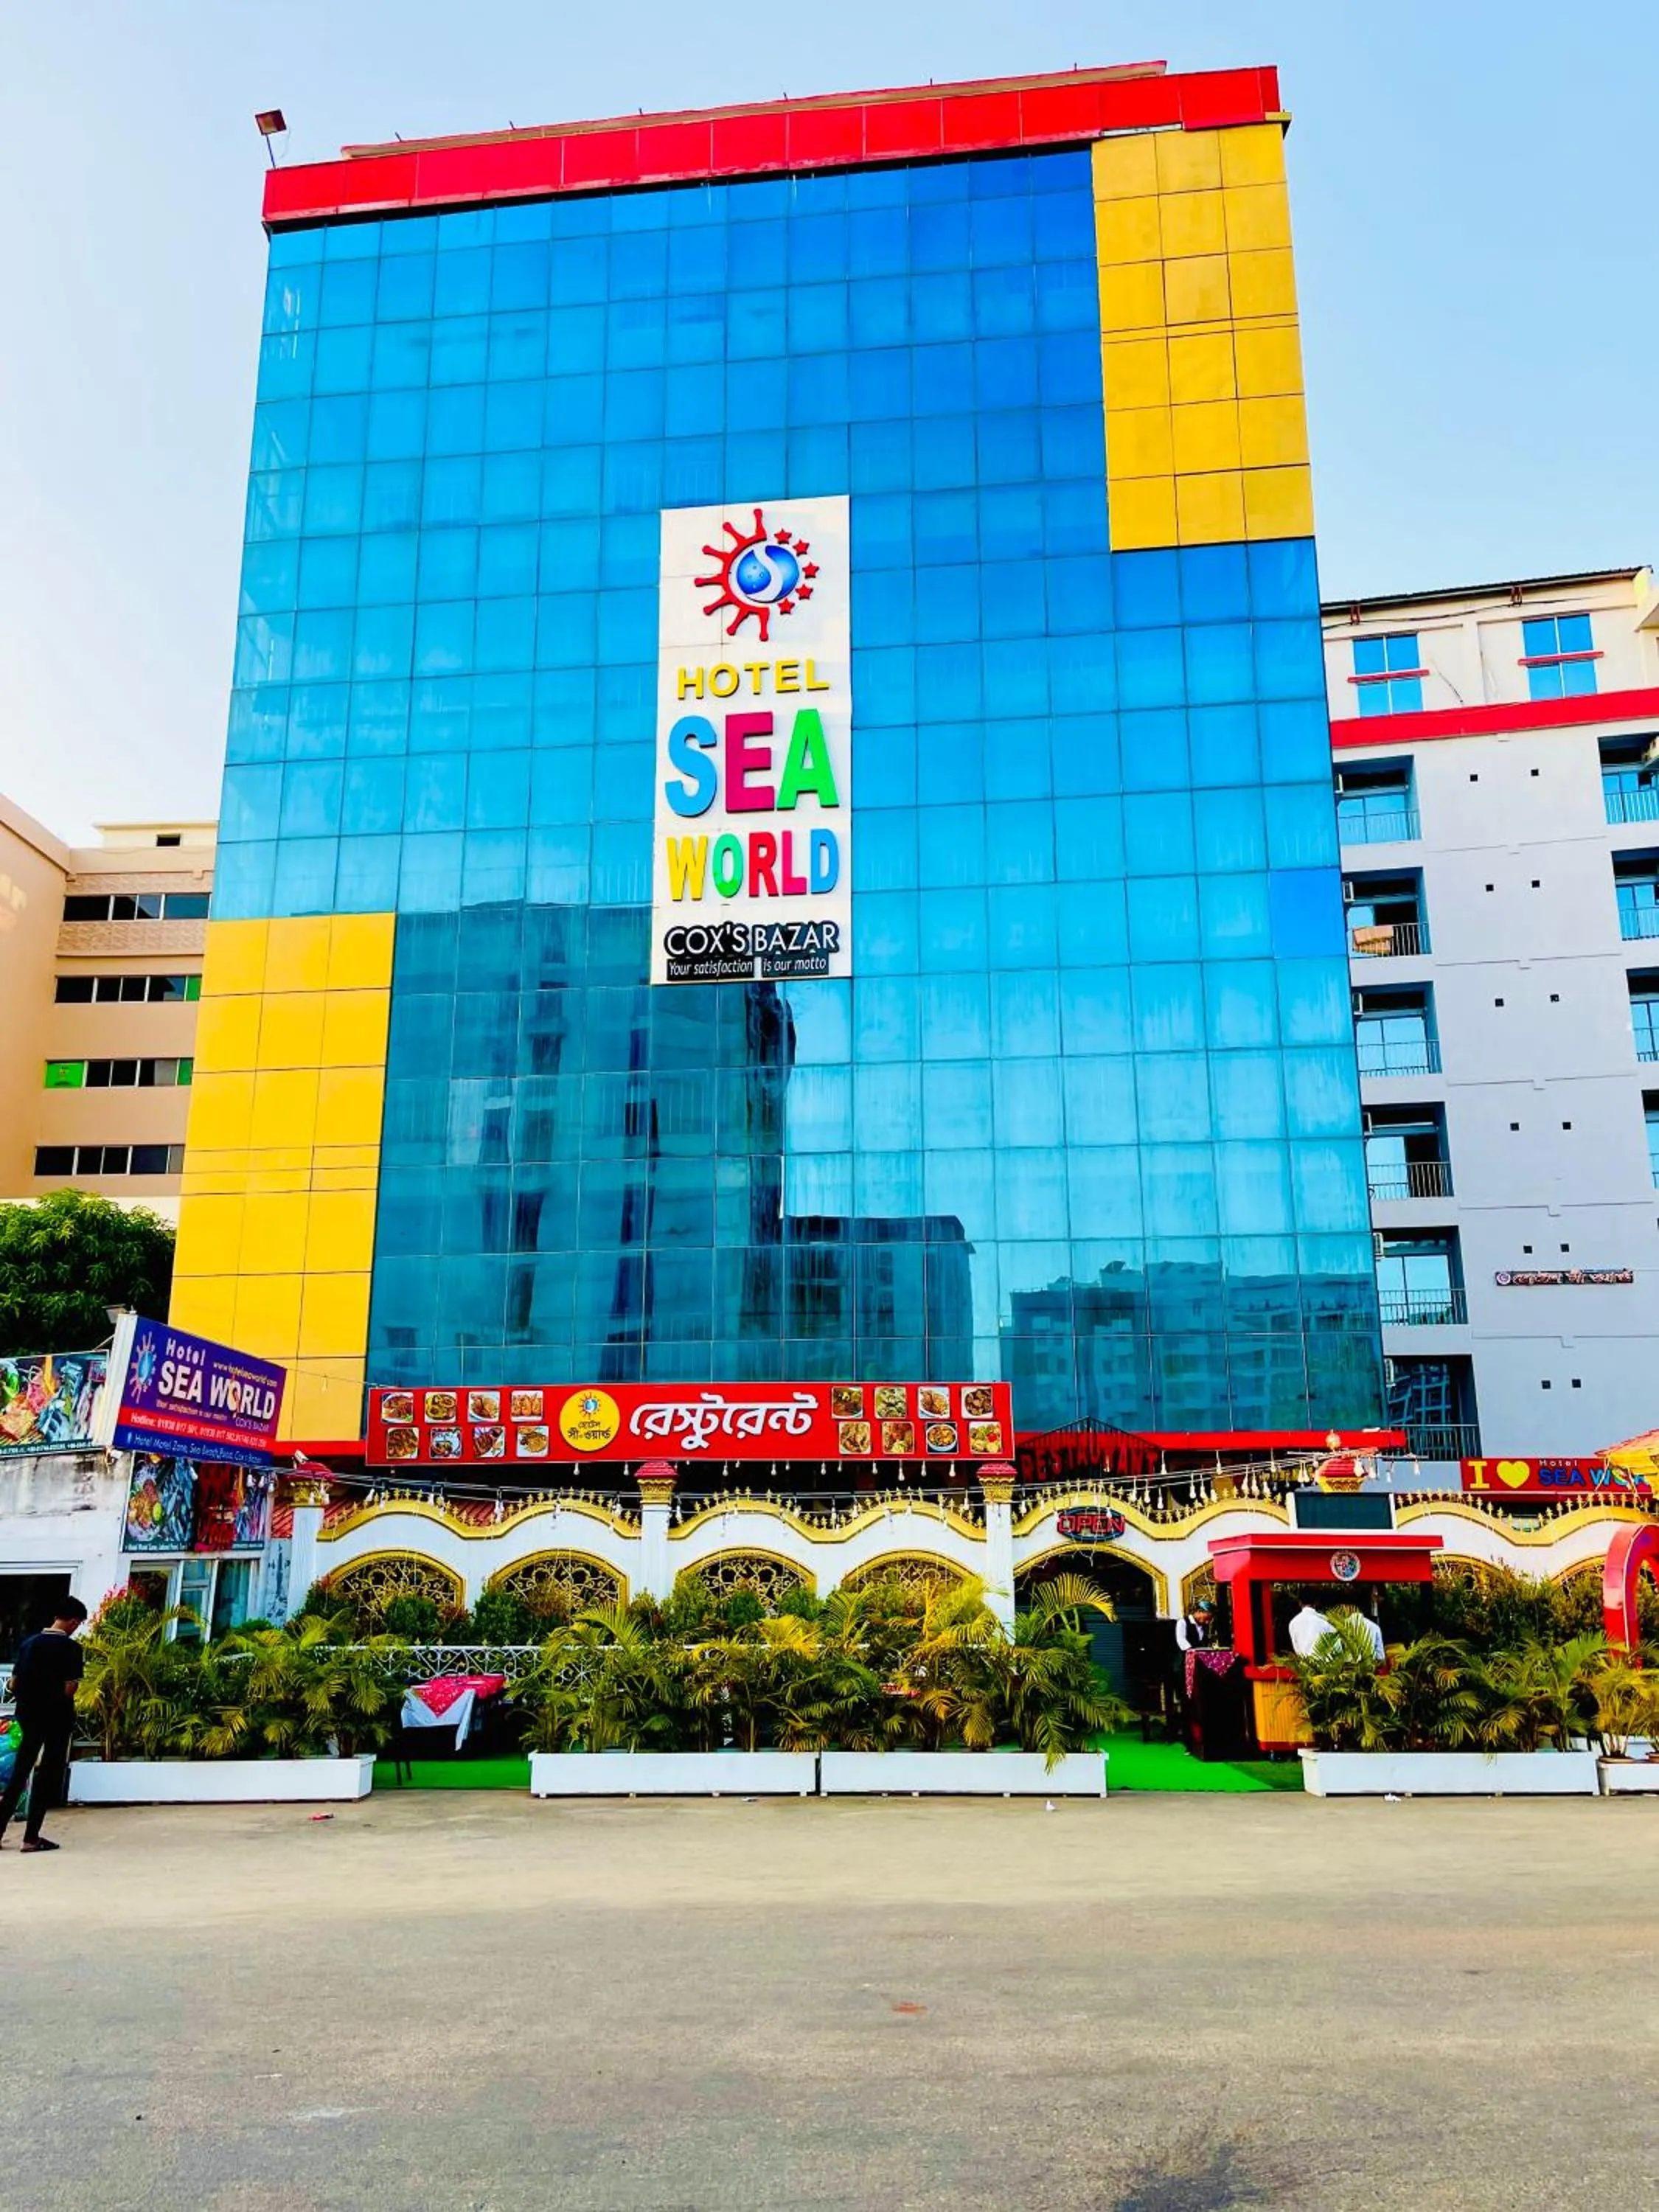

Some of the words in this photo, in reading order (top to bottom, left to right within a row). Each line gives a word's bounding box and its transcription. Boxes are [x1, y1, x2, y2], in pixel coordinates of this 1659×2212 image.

[677, 658, 830, 699] HOTEL
[664, 708, 840, 818] SEA
[665, 827, 840, 901] WORLD
[667, 927, 746, 955] COX'S
[754, 923, 835, 952] BAZAR
[669, 961, 691, 976] Your
[694, 959, 753, 976] satisfaction
[763, 959, 771, 971] is
[774, 961, 791, 971] our
[794, 958, 827, 970] motto
[166, 1338, 206, 1366] Hotel
[158, 1360, 203, 1403] SEA
[210, 1374, 276, 1420] WORLD
[630, 1392, 819, 1450] রেস্টুরেন্ট
[1468, 1461, 1489, 1489] I
[1538, 1467, 1585, 1486] SEA
[1057, 1514, 1125, 1534] OPEN
